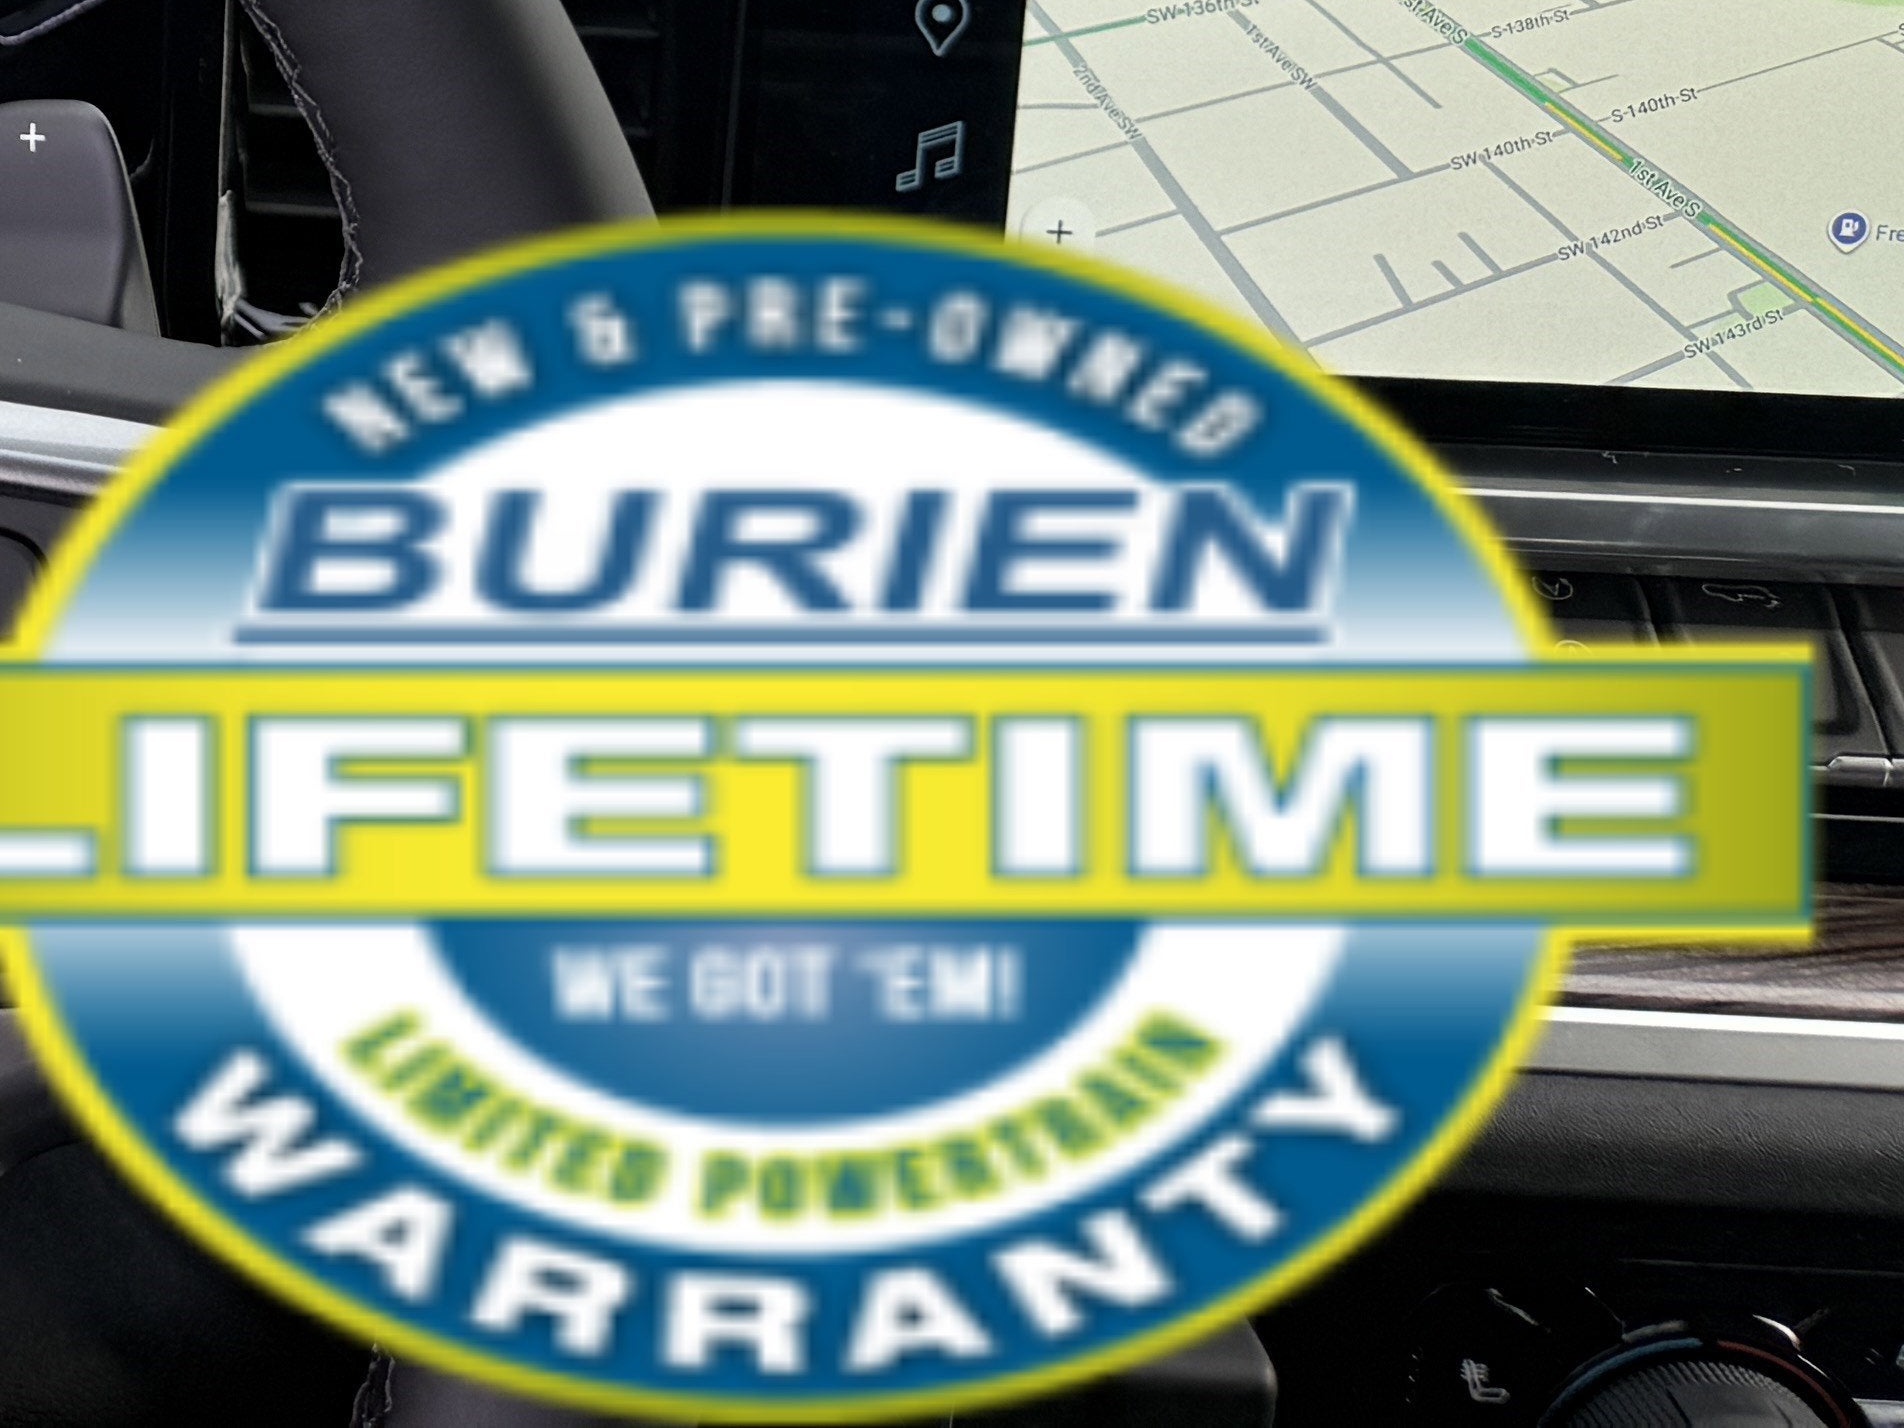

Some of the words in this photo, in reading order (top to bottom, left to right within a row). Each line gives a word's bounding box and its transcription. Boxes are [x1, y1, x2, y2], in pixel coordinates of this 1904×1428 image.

[1147, 5, 1177, 24] SW
[1422, 6, 1454, 35] Ave
[1452, 28, 1468, 45] S
[1492, 26, 1502, 39] S
[1507, 14, 1550, 35] 138th
[1553, 9, 1570, 23] St
[1246, 25, 1269, 49] 1st
[1266, 45, 1293, 72] Ave
[1291, 66, 1318, 91] SW
[1073, 65, 1100, 95] 2nd
[1096, 90, 1122, 121] Ave
[1117, 117, 1143, 141] SW
[1611, 108, 1624, 122] S
[1628, 93, 1676, 118] 140th
[1679, 88, 1699, 103] St
[1450, 151, 1479, 171] SW
[1483, 136, 1532, 161] 140th
[1534, 130, 1554, 146] St
[1629, 160, 1656, 185] 1st
[1654, 179, 1686, 210] Ave
[1684, 199, 1701, 218] S
[1557, 241, 1587, 261] SW
[1589, 223, 1642, 249] 142nd
[1644, 214, 1664, 231] St
[1684, 338, 1712, 358] SW
[1715, 317, 1764, 346] 143rd
[1765, 309, 1784, 325] St
